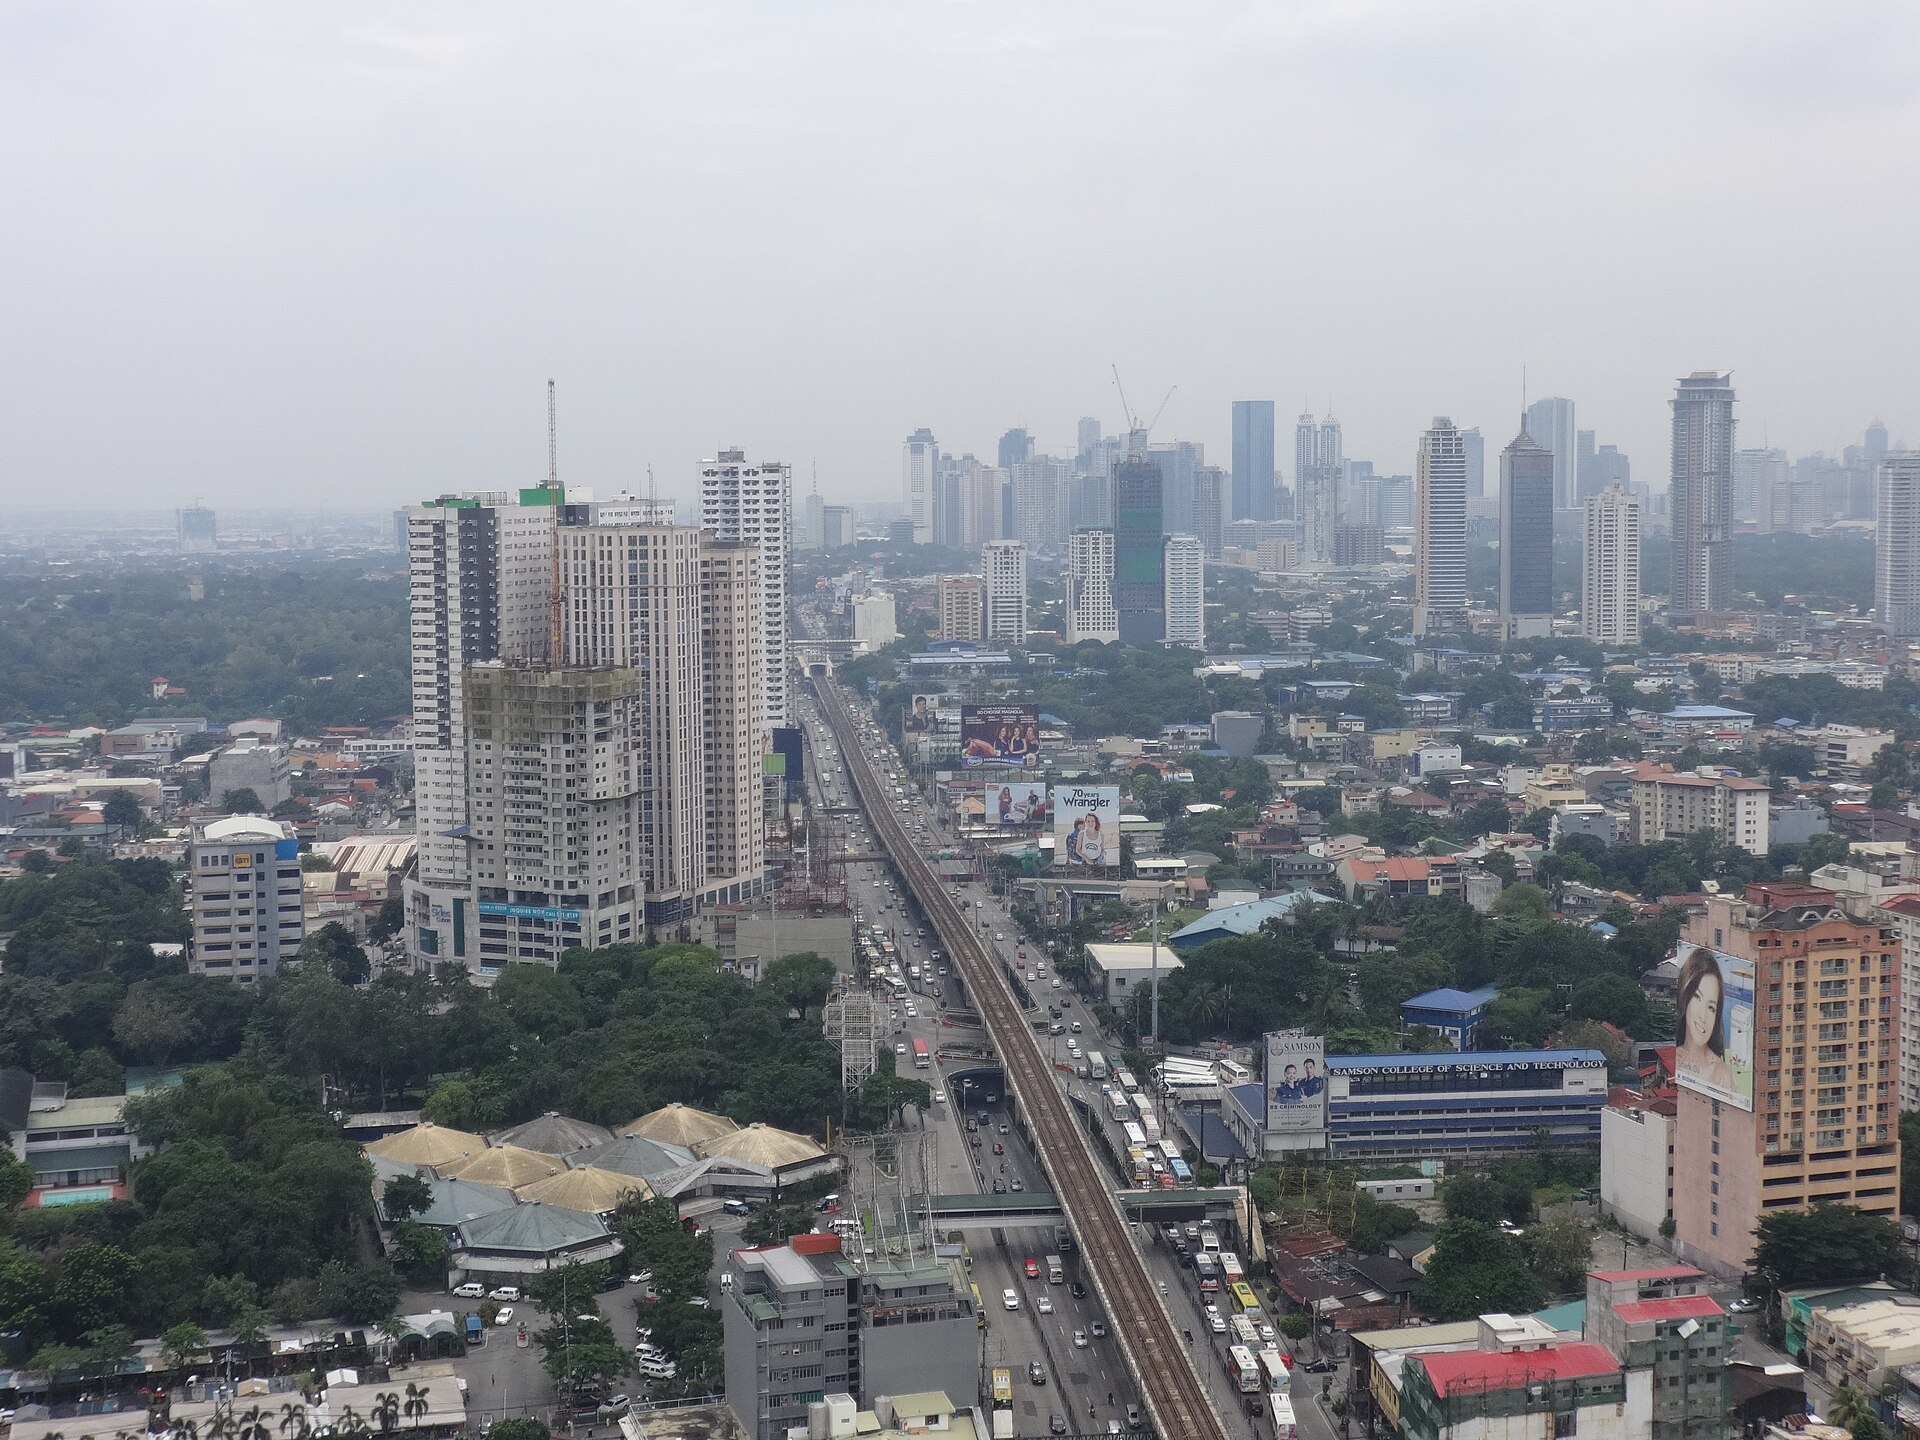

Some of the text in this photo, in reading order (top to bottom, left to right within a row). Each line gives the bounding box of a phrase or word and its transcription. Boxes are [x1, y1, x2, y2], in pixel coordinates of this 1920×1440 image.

[1072, 789, 1083, 798] 70
[1062, 796, 1110, 811] Wrangler
[1284, 1041, 1321, 1052] SAMSON
[1333, 1060, 1605, 1076] SAMSON COLLEGE OF SCIENCE AND TECHNOLOGY
